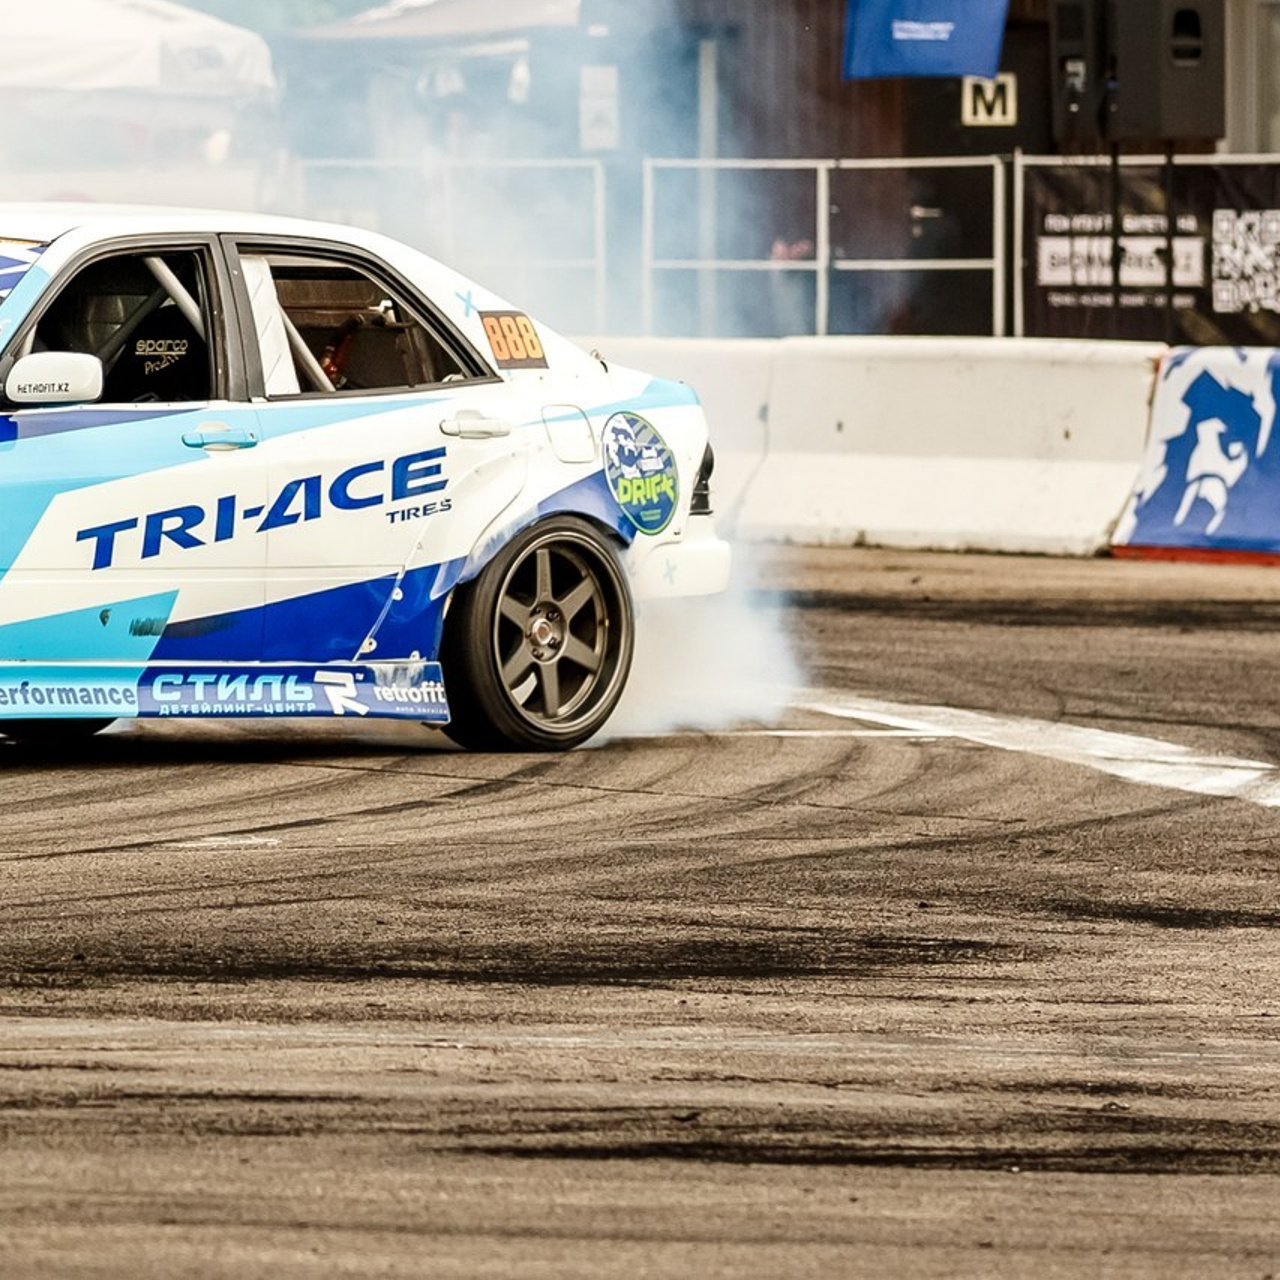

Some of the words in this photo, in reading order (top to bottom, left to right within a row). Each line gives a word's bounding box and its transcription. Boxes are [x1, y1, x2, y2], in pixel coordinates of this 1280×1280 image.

[971, 83, 1009, 117] M
[135, 339, 188, 354] sparco
[483, 315, 544, 360] 888
[76, 446, 449, 570] TRI-ACE
[386, 498, 453, 524] TIRES
[152, 674, 314, 701] СТИЛЬ
[373, 680, 446, 703] retrofit
[159, 702, 317, 716] ДЕТЕЙЛИНГ-ЦЕНТР
